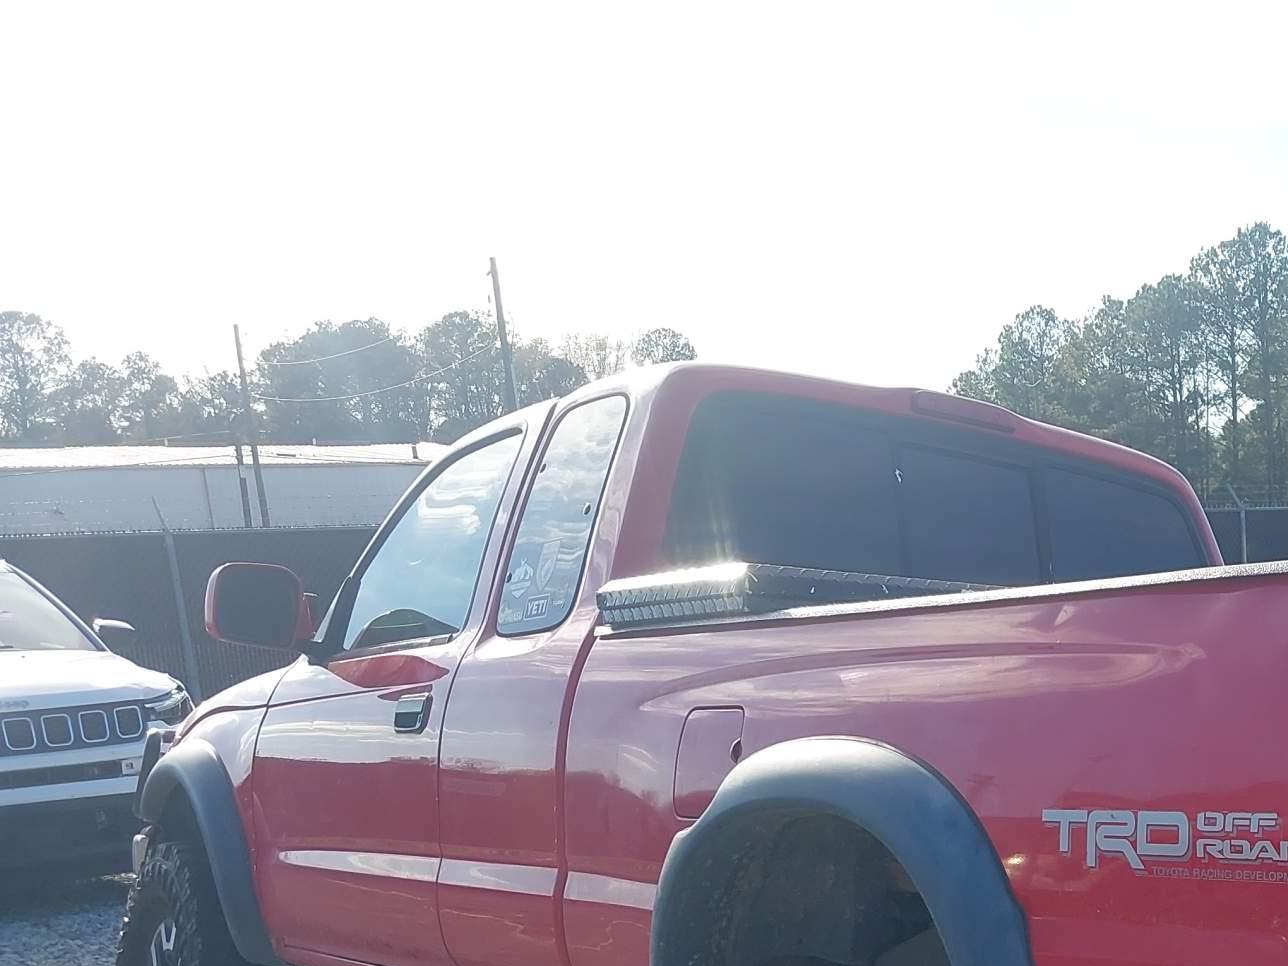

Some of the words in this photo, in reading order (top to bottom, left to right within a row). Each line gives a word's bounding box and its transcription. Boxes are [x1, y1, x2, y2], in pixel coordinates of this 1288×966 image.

[527, 599, 548, 616] YETI
[1196, 811, 1279, 834] OFF
[1042, 809, 1191, 870] TRD
[1151, 866, 1190, 879] TOYOTA
[1192, 868, 1233, 880] RACING
